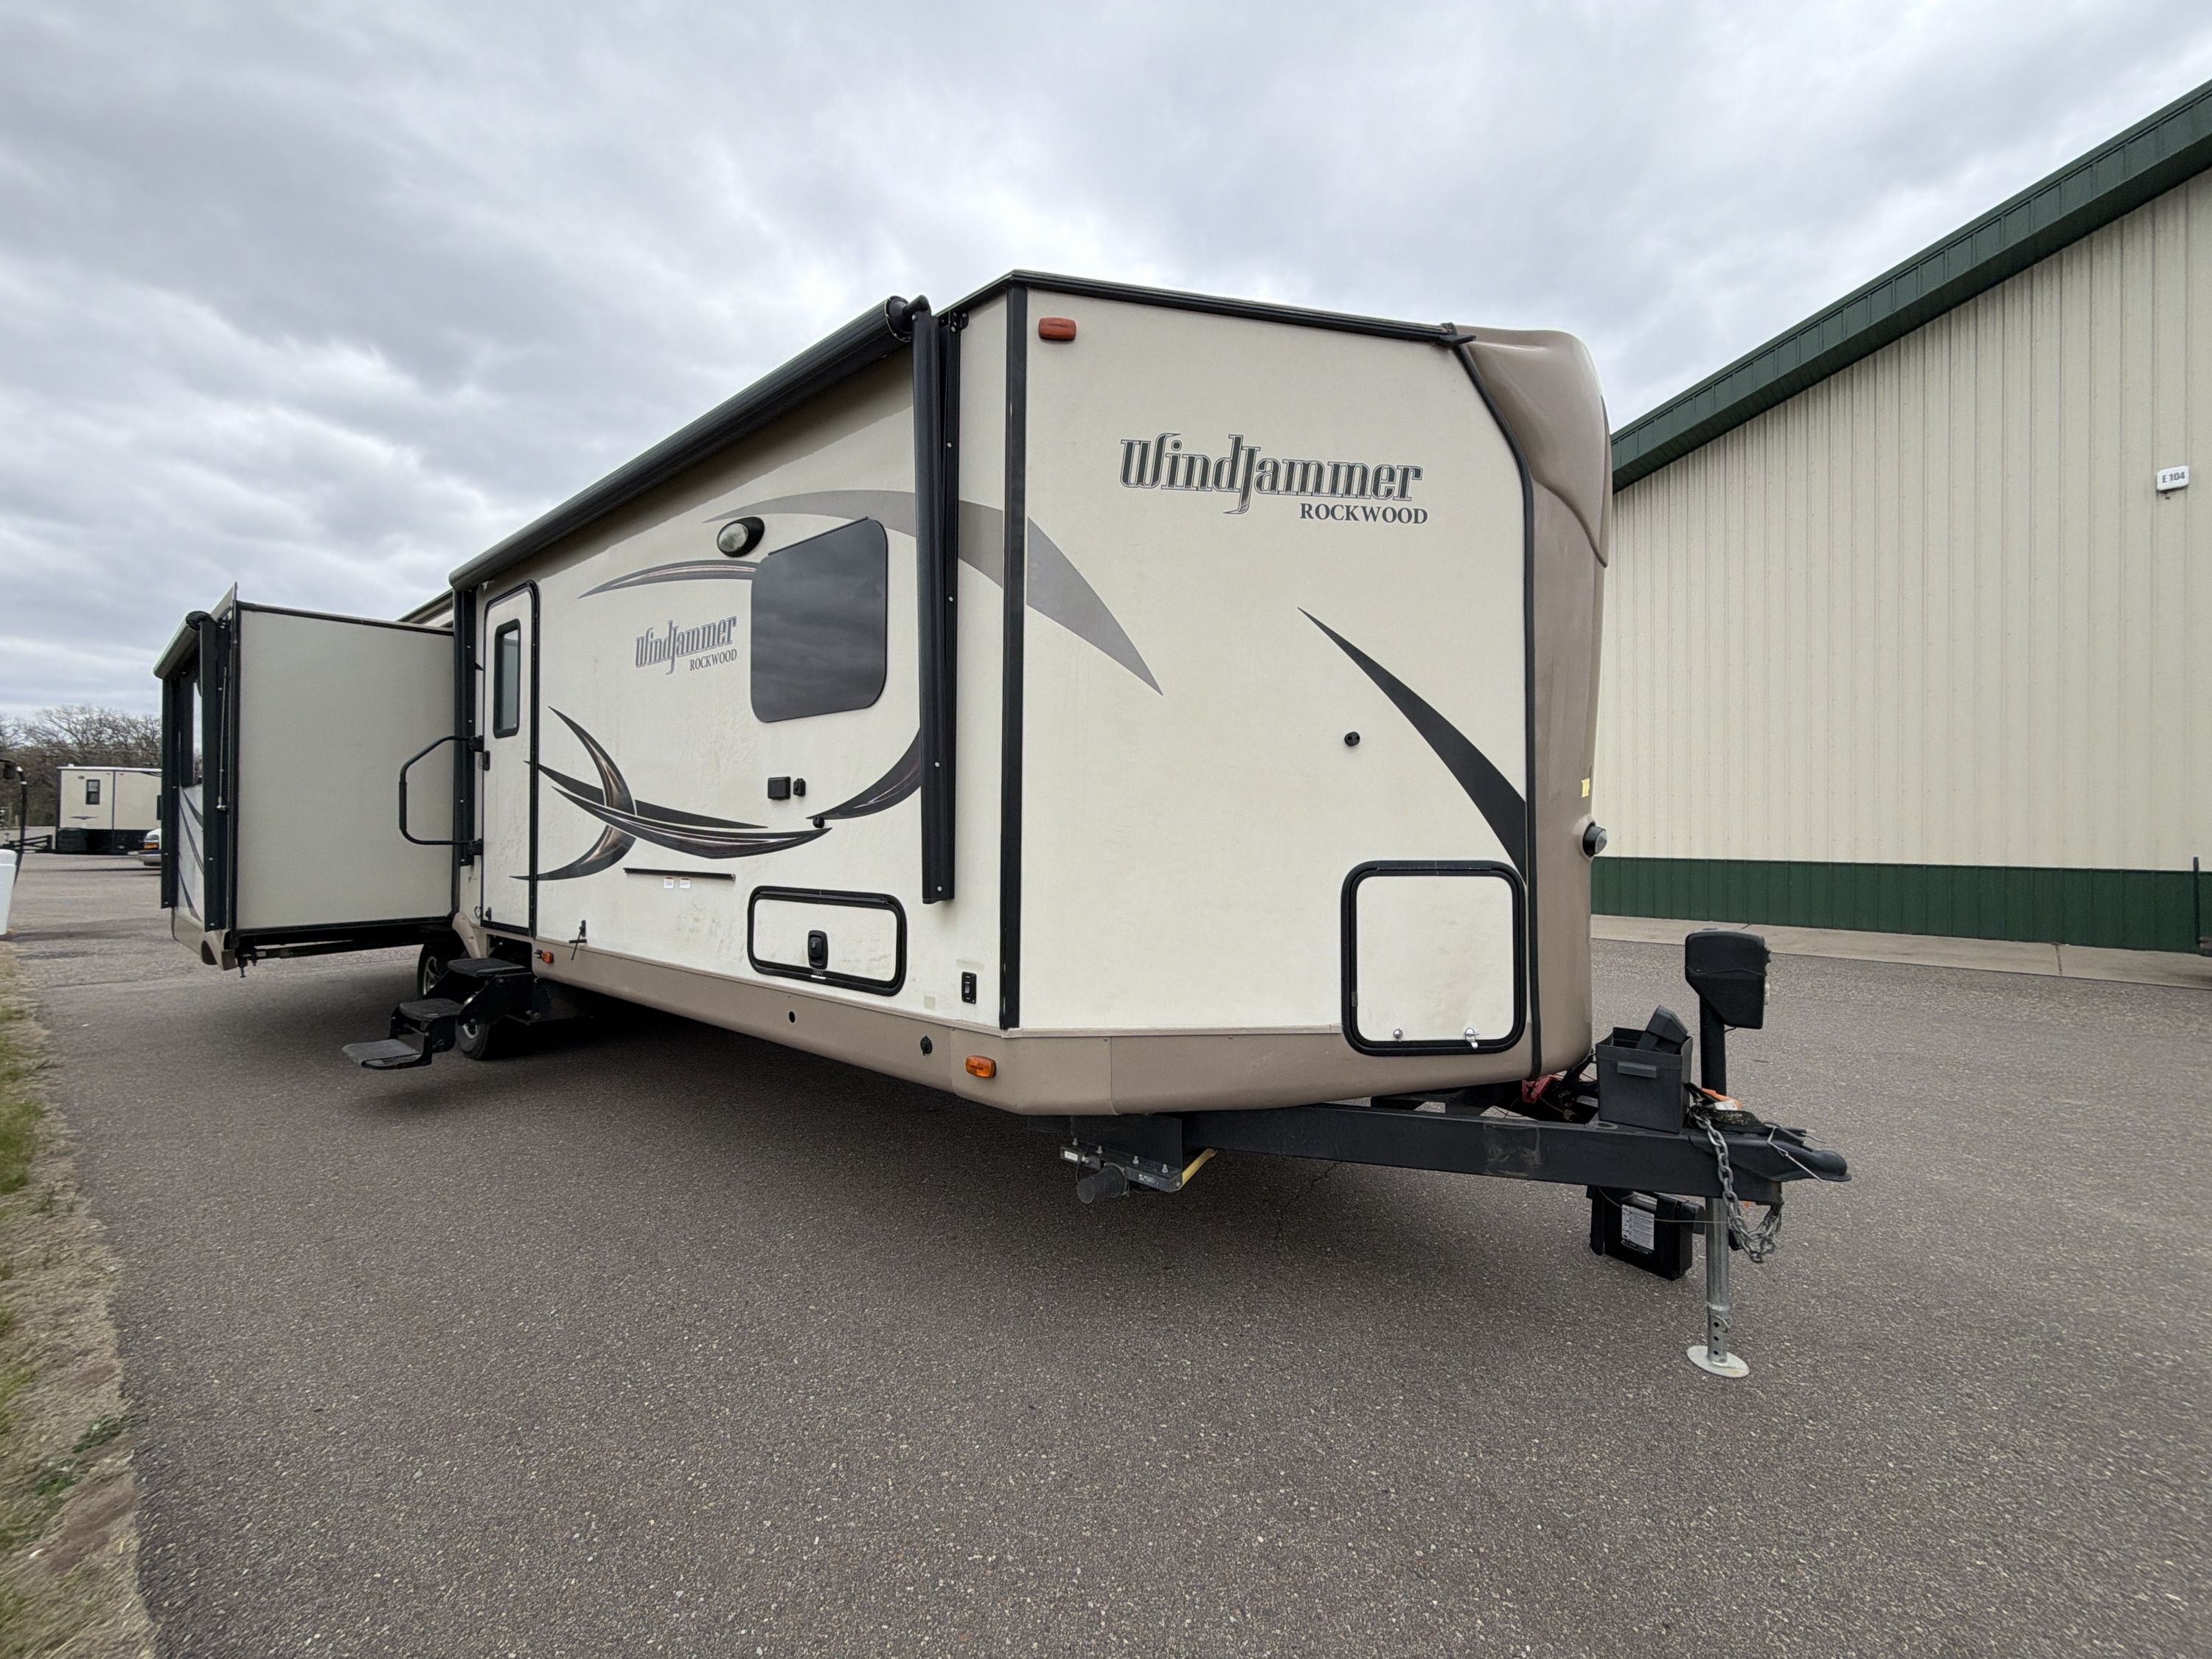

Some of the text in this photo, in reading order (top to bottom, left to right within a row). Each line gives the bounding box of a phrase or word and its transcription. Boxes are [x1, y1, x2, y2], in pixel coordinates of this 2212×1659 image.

[1119, 433, 1424, 515] WindJammer
[2162, 471, 2185, 483] E 104
[1299, 503, 1428, 524] ROCKWOOD
[635, 616, 737, 675] WindJammer
[689, 648, 737, 671] ROCKWOOD
